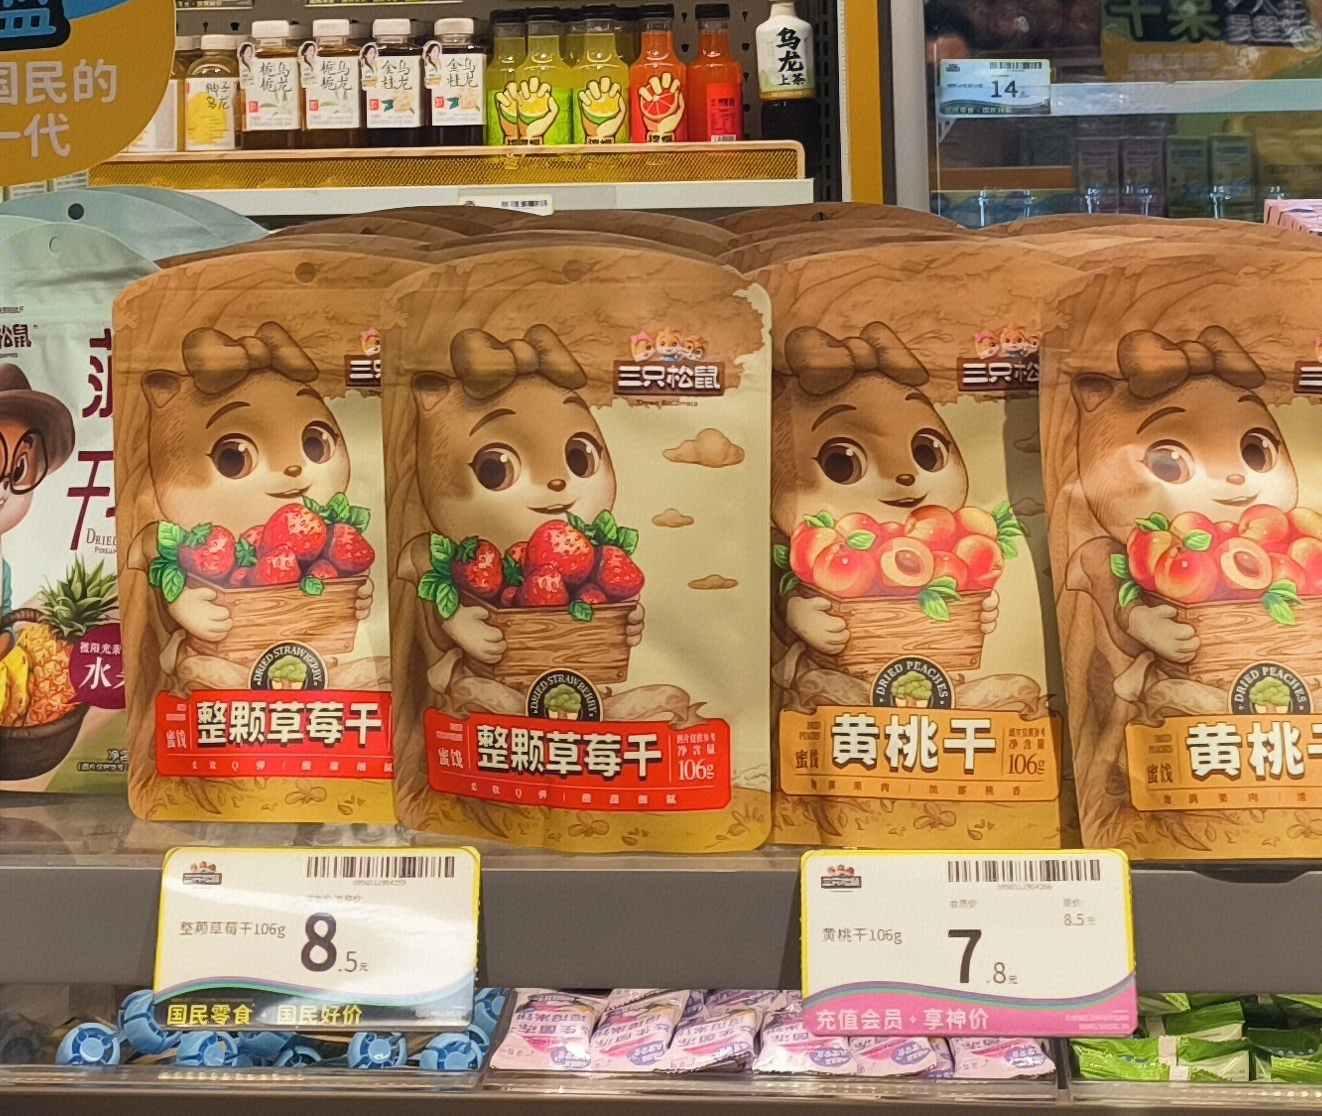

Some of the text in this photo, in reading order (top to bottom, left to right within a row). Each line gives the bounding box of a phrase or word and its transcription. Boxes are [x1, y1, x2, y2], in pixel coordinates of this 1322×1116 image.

[617, 365, 721, 391] 三只松鼠
[196, 700, 383, 746] 整颗草莓干
[830, 712, 997, 771] 黄桃干
[477, 724, 663, 778] 整颗草莓干
[1007, 753, 1046, 776] 106g
